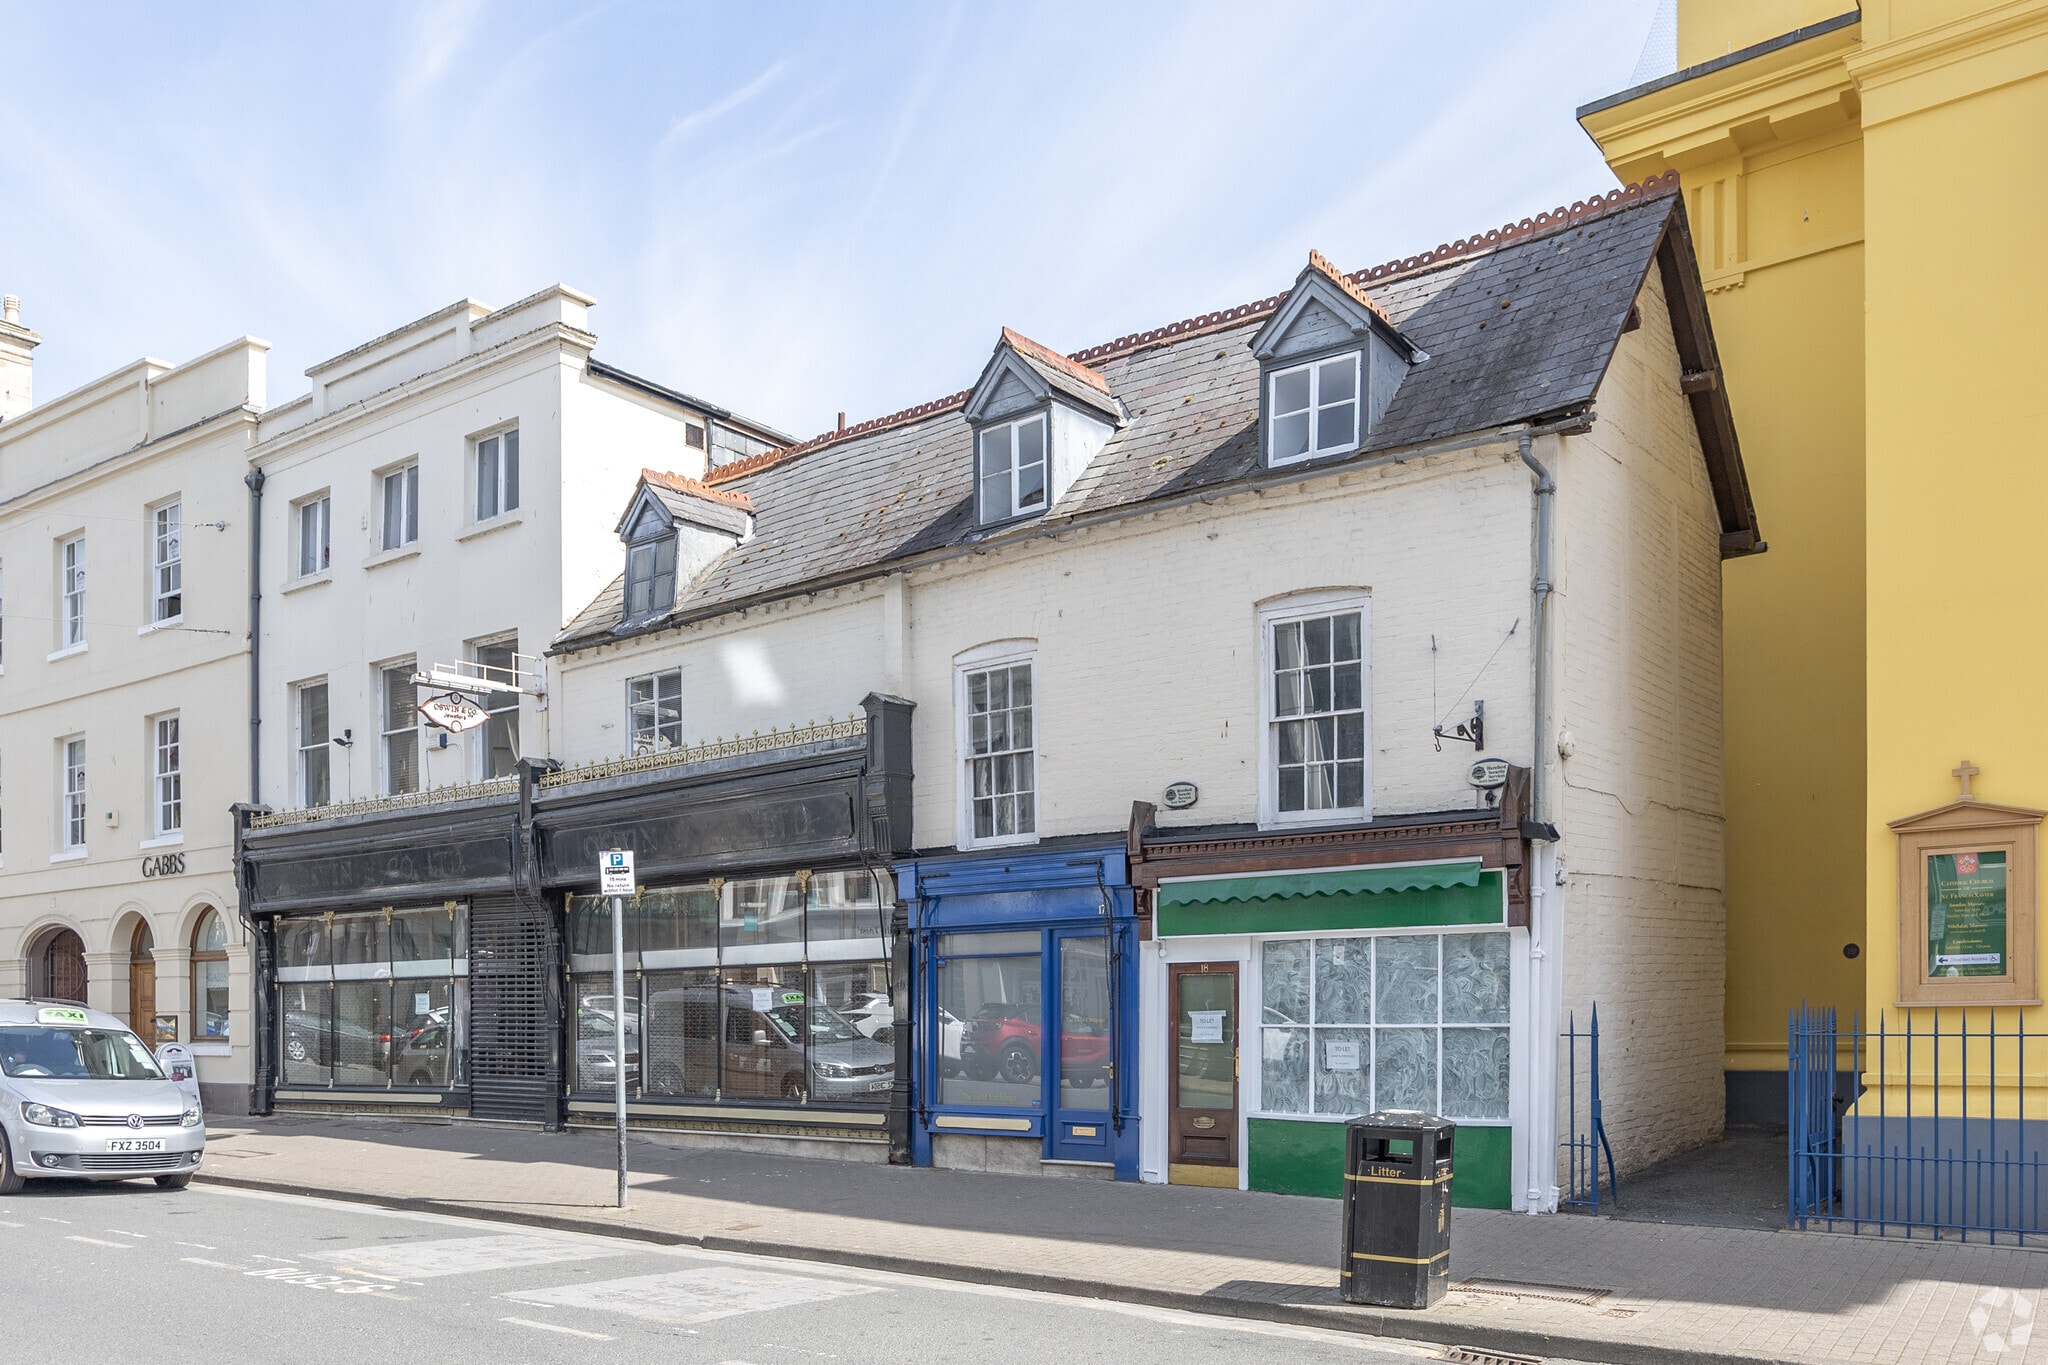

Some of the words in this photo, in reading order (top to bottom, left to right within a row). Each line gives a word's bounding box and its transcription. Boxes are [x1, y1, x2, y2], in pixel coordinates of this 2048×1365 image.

[433, 703, 460, 713] OSWIN
[142, 852, 185, 878] GABBS
[613, 855, 622, 865] P
[1200, 963, 1209, 974] 18
[44, 1011, 84, 1019] TAXI
[961, 1092, 973, 1101] The
[110, 1141, 133, 1151] FXZ
[134, 1140, 161, 1151] 3504
[1370, 1165, 1402, 1178] Litter
